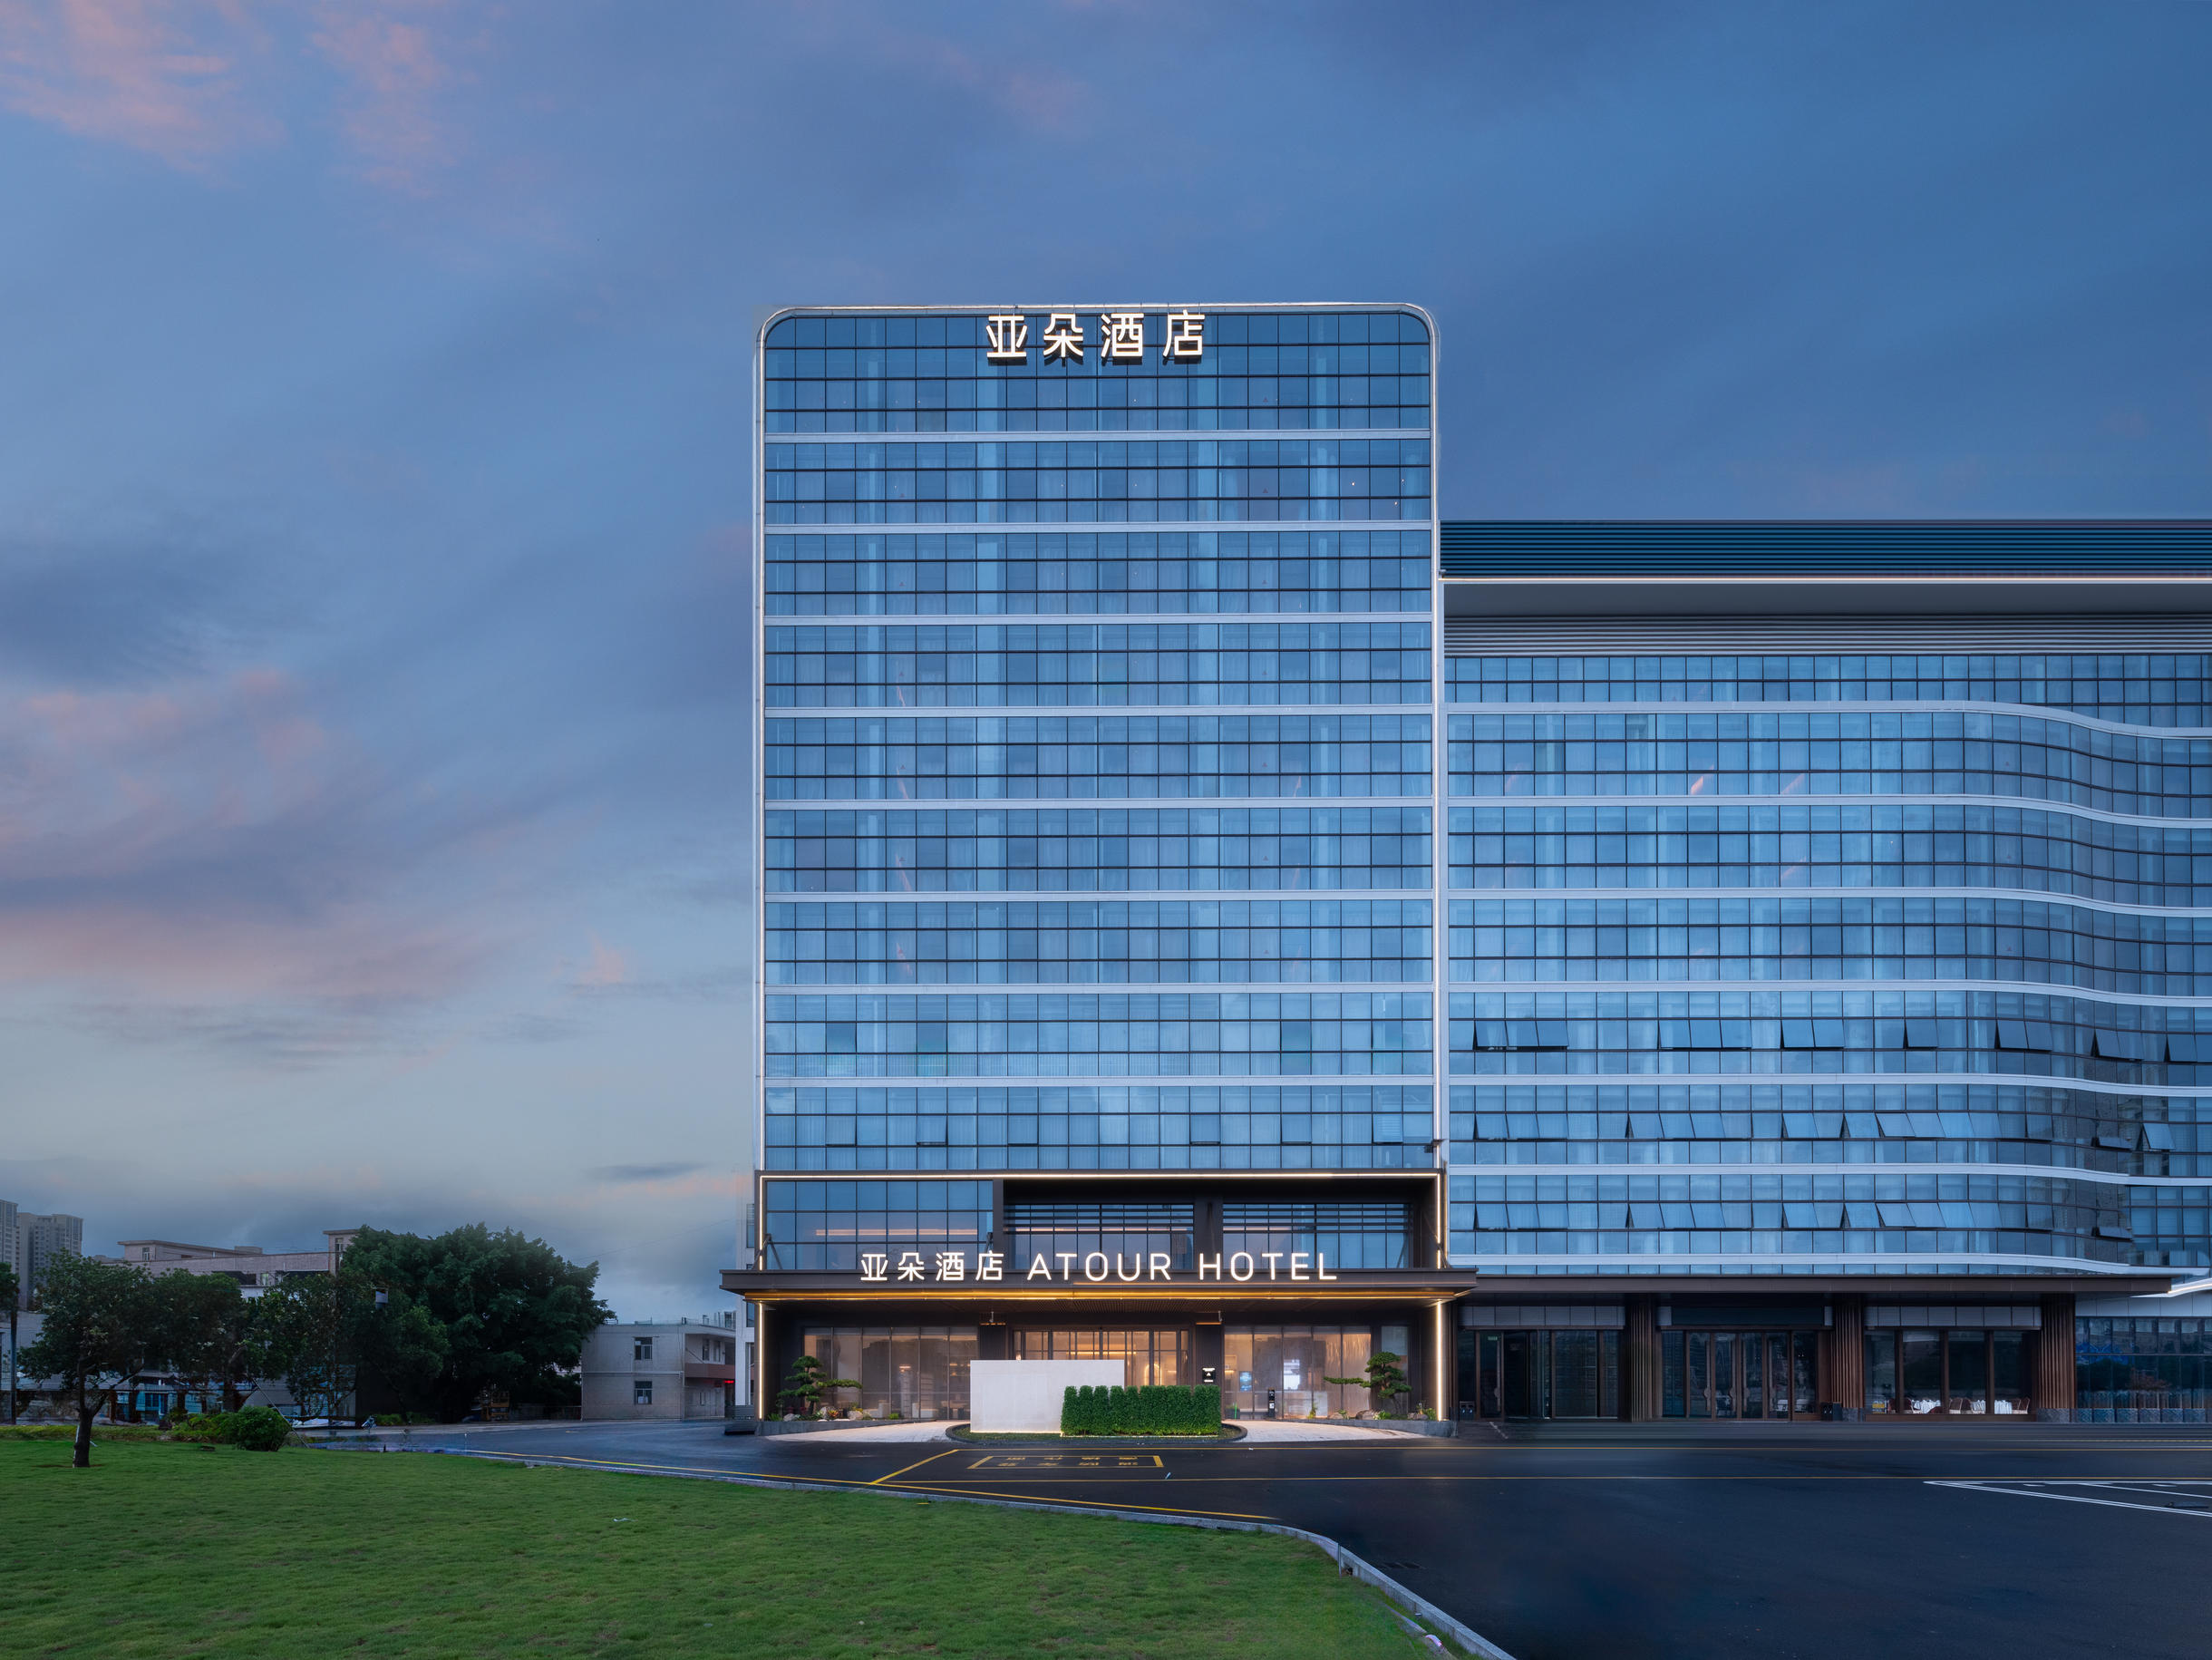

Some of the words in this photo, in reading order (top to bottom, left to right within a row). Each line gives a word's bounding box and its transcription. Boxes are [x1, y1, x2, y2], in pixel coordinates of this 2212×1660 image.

[985, 309, 1206, 358] 亚朵酒店
[860, 1250, 1004, 1281] 亚朵酒店
[1026, 1252, 1172, 1281] ATOUR
[1198, 1252, 1338, 1281] HOTEL
